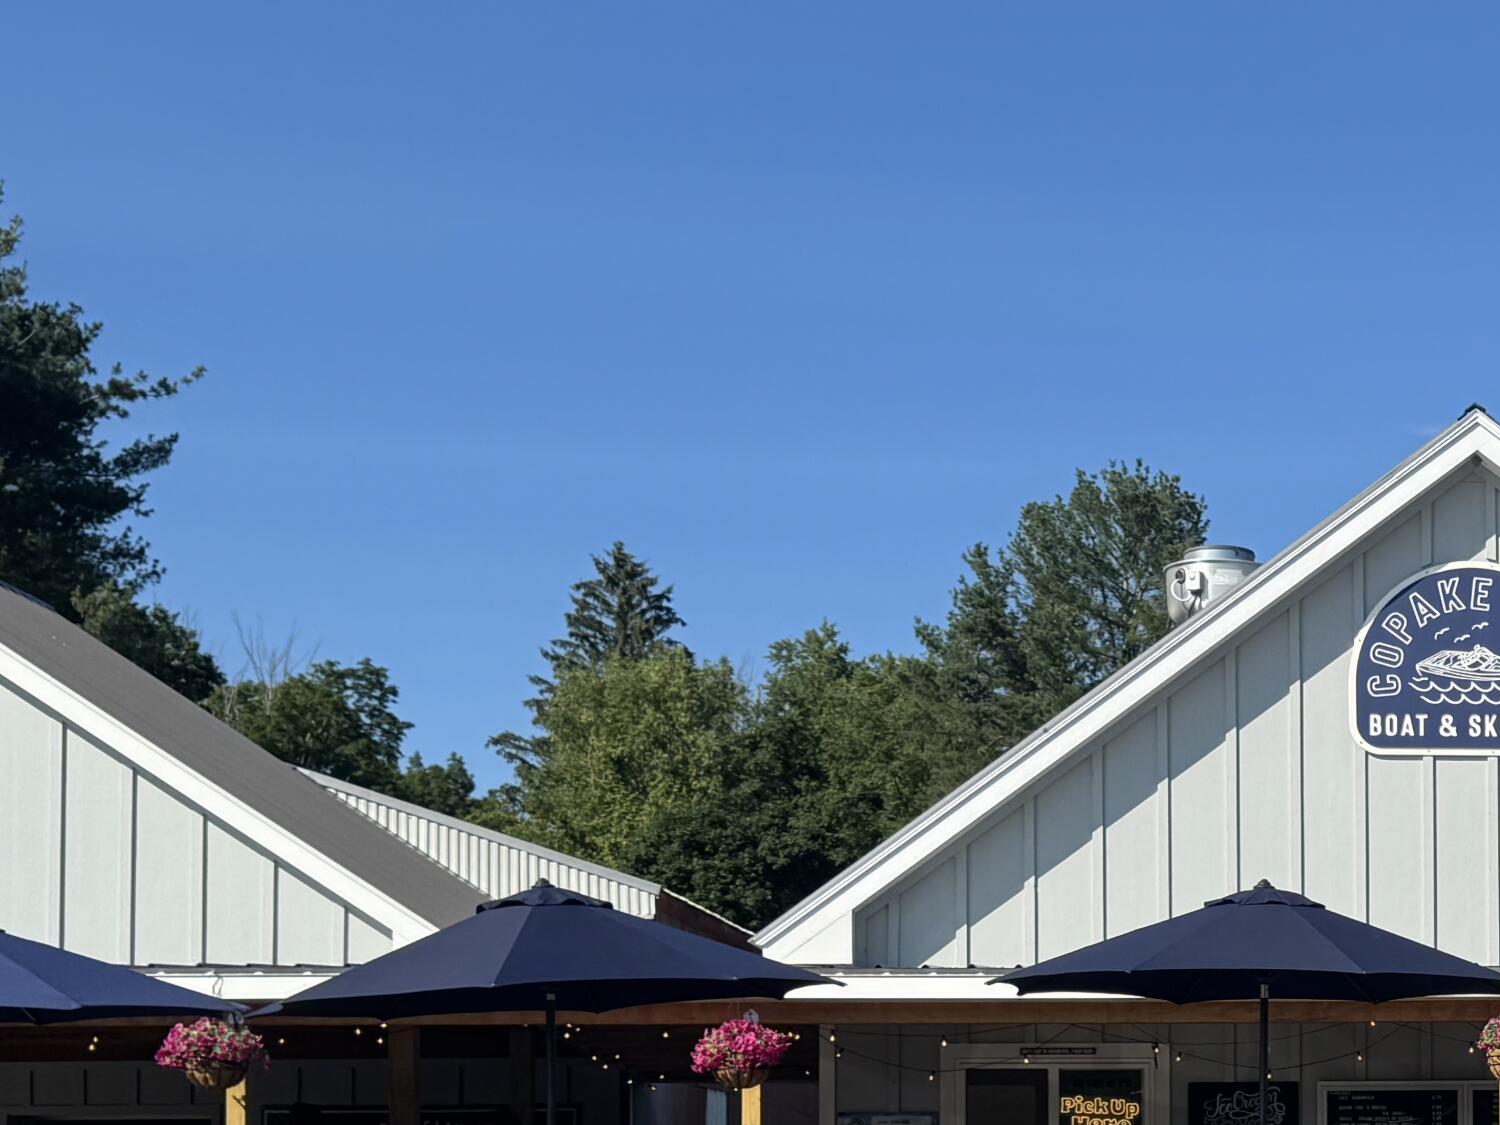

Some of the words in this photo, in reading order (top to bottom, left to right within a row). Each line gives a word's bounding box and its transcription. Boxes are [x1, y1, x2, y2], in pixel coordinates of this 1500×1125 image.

[1366, 576, 1493, 698] COPAKE
[1369, 713, 1428, 737] BOAT
[1438, 713, 1458, 737] &
[1060, 1095, 1109, 1115] Pick
[1110, 1098, 1140, 1119] Up
